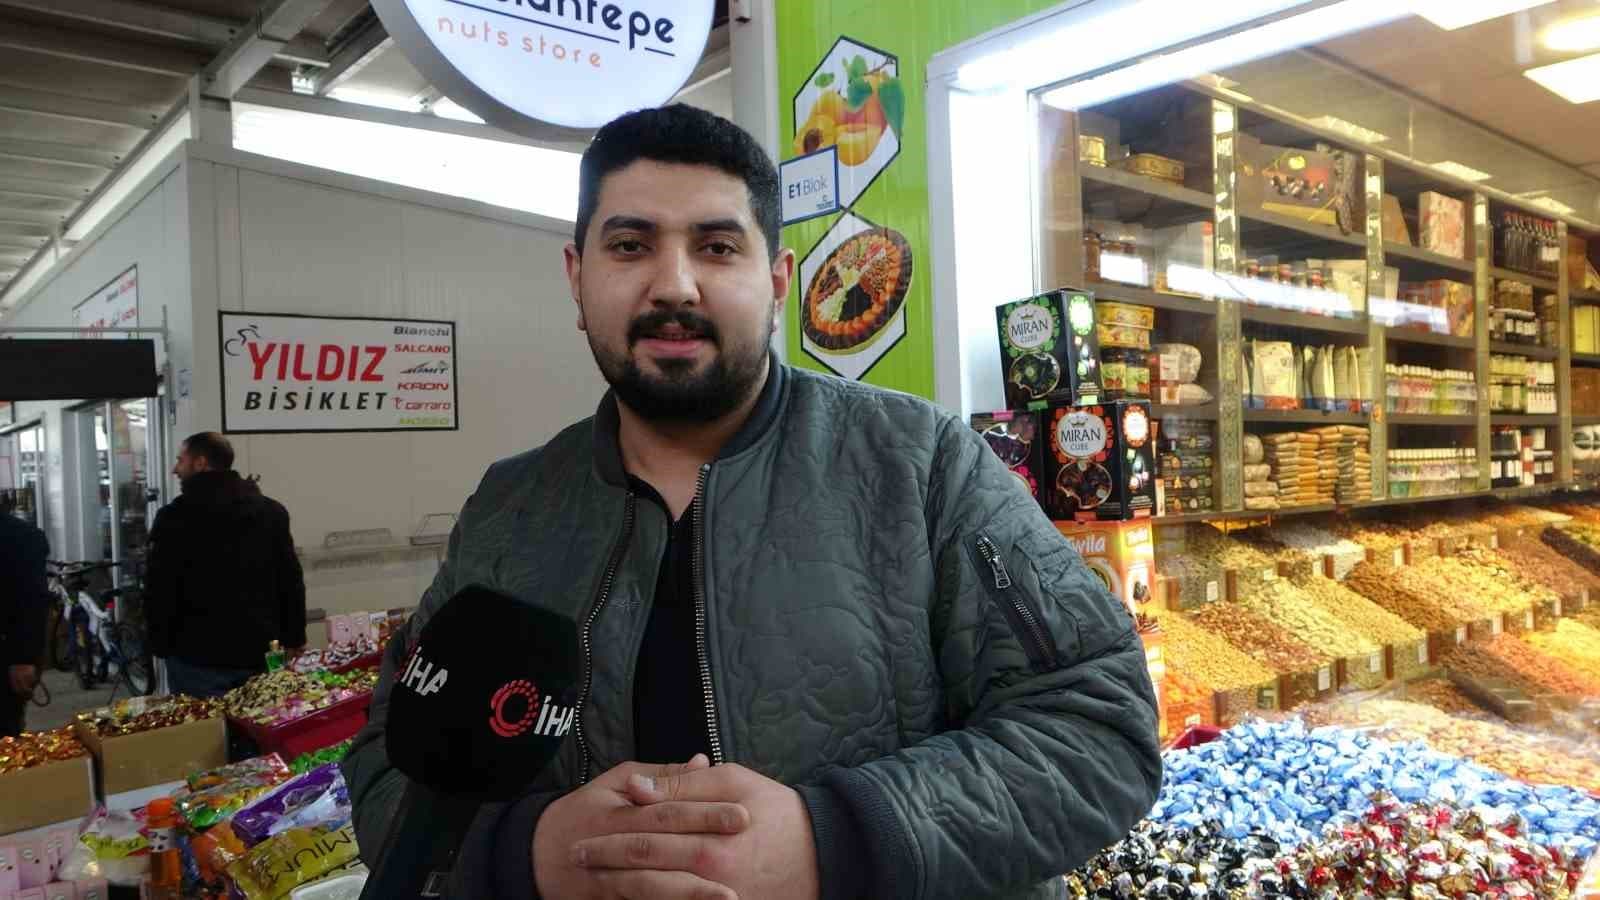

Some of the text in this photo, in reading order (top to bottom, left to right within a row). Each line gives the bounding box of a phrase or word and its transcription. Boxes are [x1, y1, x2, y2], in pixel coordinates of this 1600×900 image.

[437, 16, 602, 67] nuts store
[788, 175, 829, 199] E1 Blok
[393, 326, 449, 336] Bianchi
[1010, 319, 1049, 337] MIRAN
[394, 344, 450, 353] SALCANO
[248, 342, 387, 382] YILDIZ
[244, 386, 388, 411] BİSİKLET
[1060, 429, 1100, 443] MIRAN
